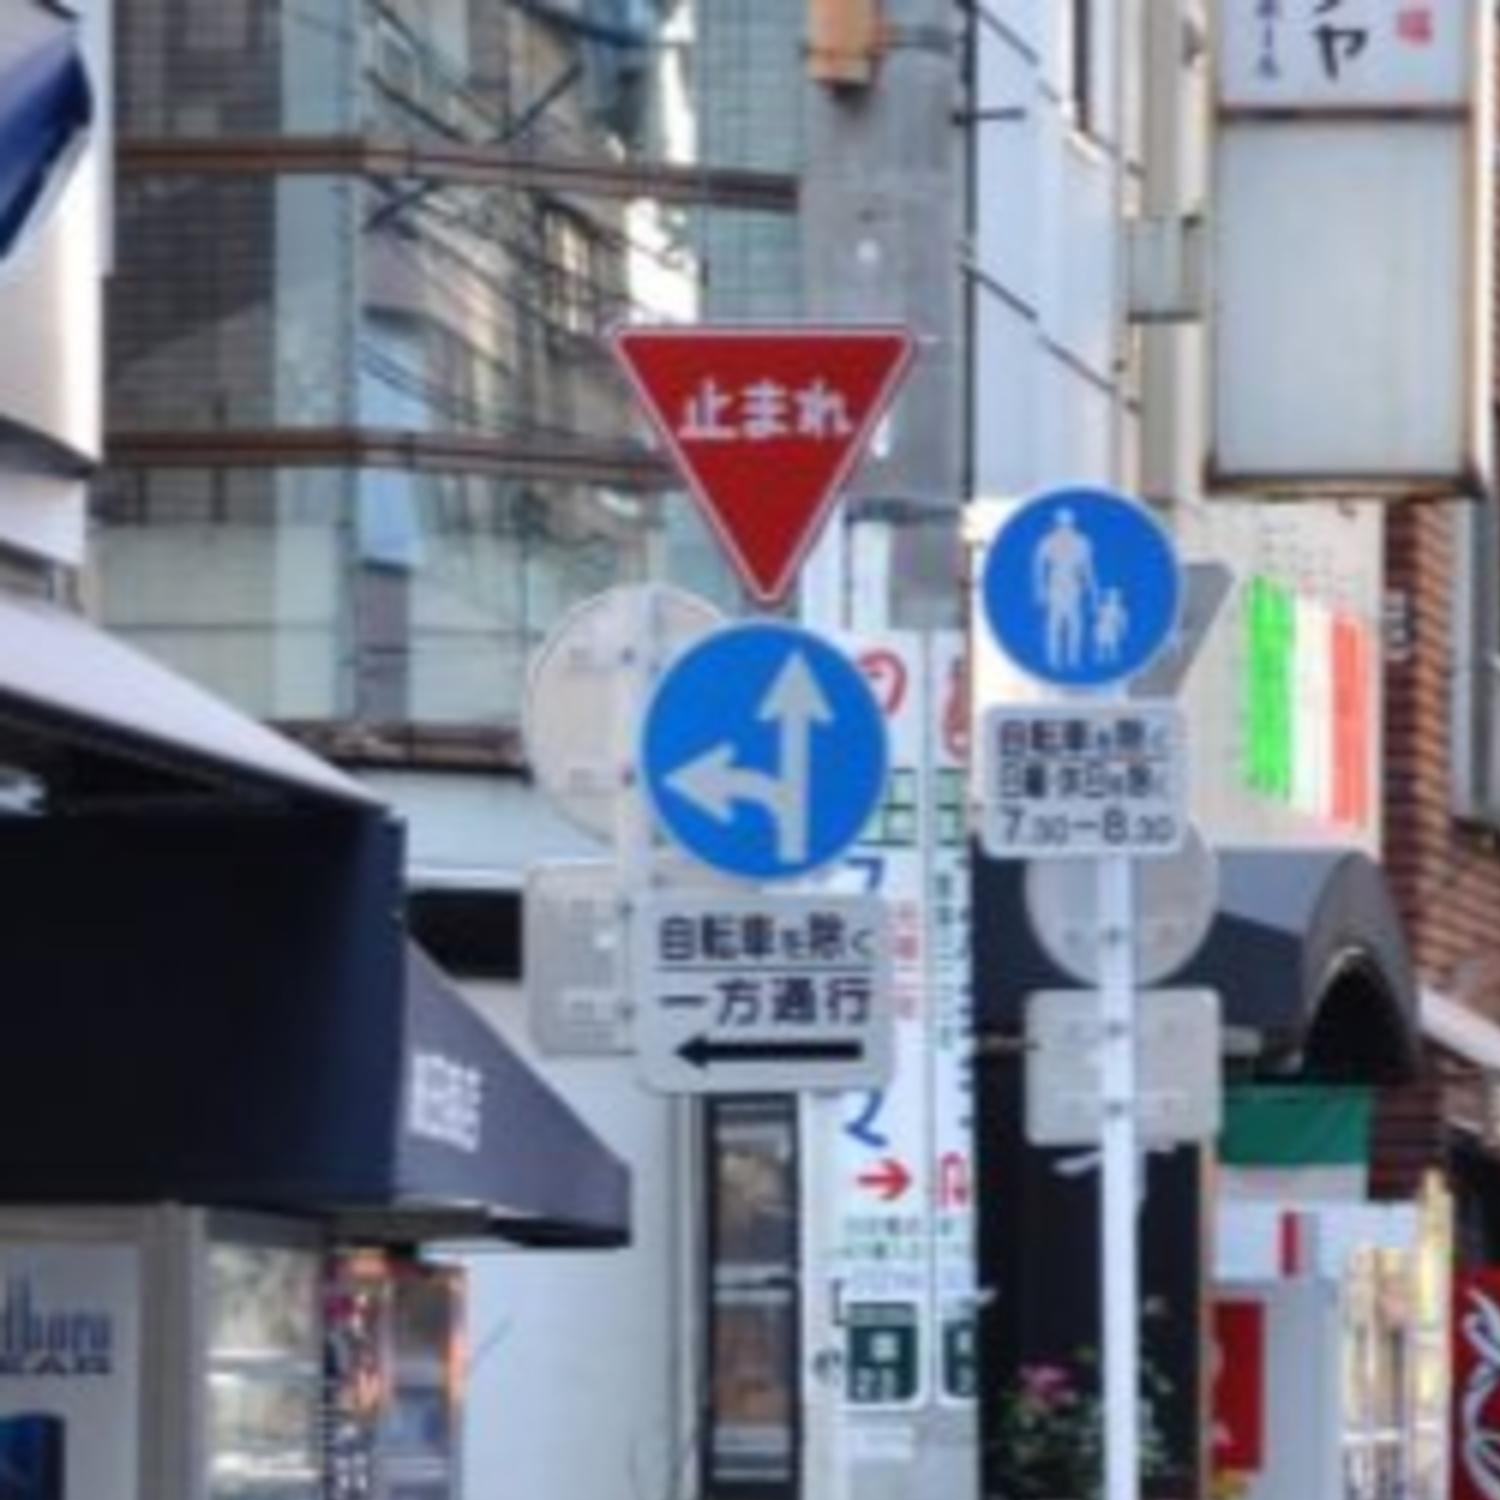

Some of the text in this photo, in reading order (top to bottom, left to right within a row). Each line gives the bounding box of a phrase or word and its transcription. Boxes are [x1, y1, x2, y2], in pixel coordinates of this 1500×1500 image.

[679, 381, 851, 440] 止まれ
[659, 913, 876, 961] 自転車を除く
[658, 977, 871, 1025] 一方通行
